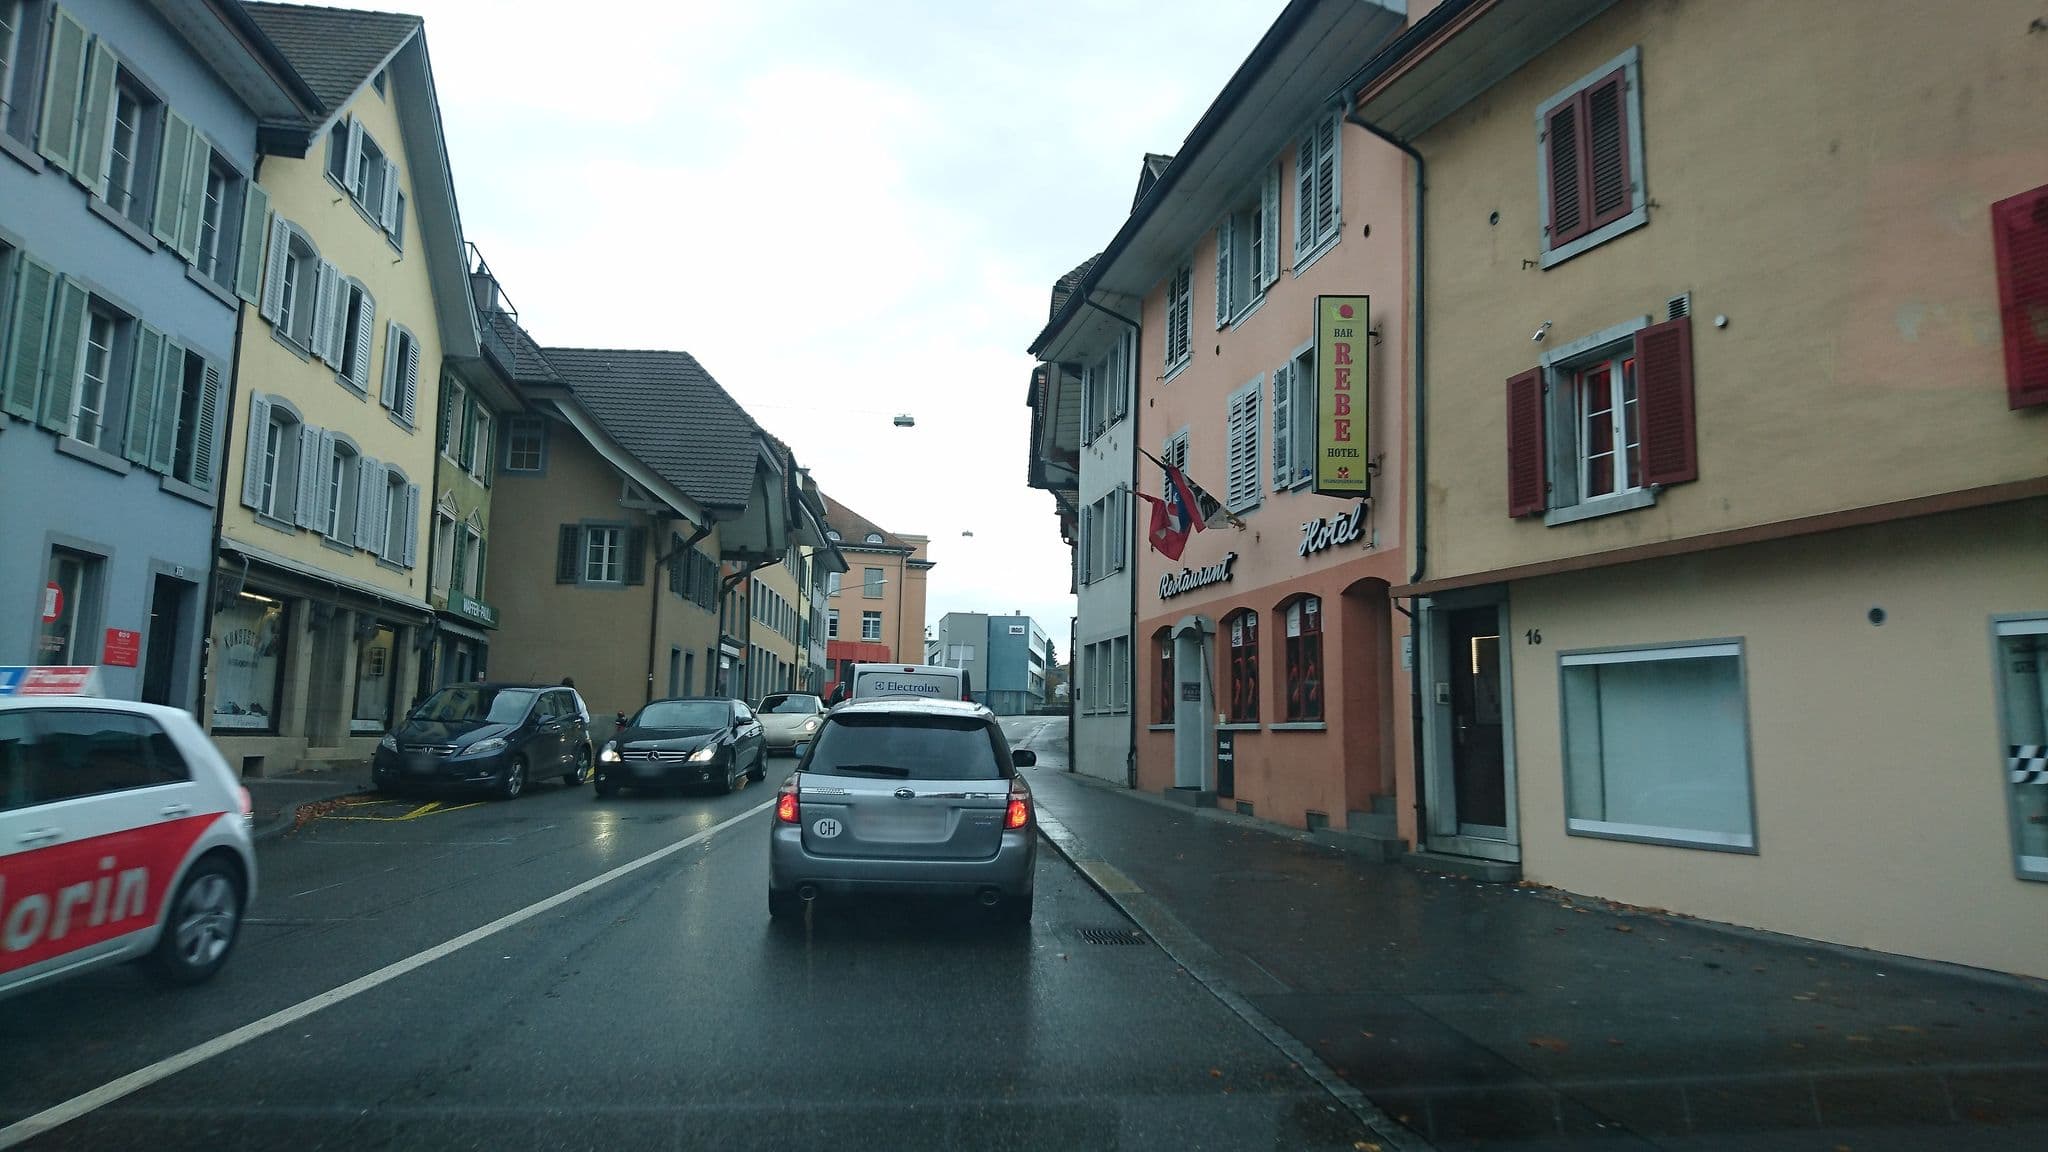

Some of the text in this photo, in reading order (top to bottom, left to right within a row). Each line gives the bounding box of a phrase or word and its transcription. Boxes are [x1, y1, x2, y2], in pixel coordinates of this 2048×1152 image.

[1333, 328, 1353, 338] BAR
[1334, 342, 1353, 442] REBE
[1327, 447, 1360, 458] HOTEL
[1299, 503, 1364, 557] Hotel
[1159, 553, 1236, 600] Restaurant
[1525, 629, 1542, 645] 16
[887, 681, 941, 693] Electrolux
[819, 821, 836, 836] CH
